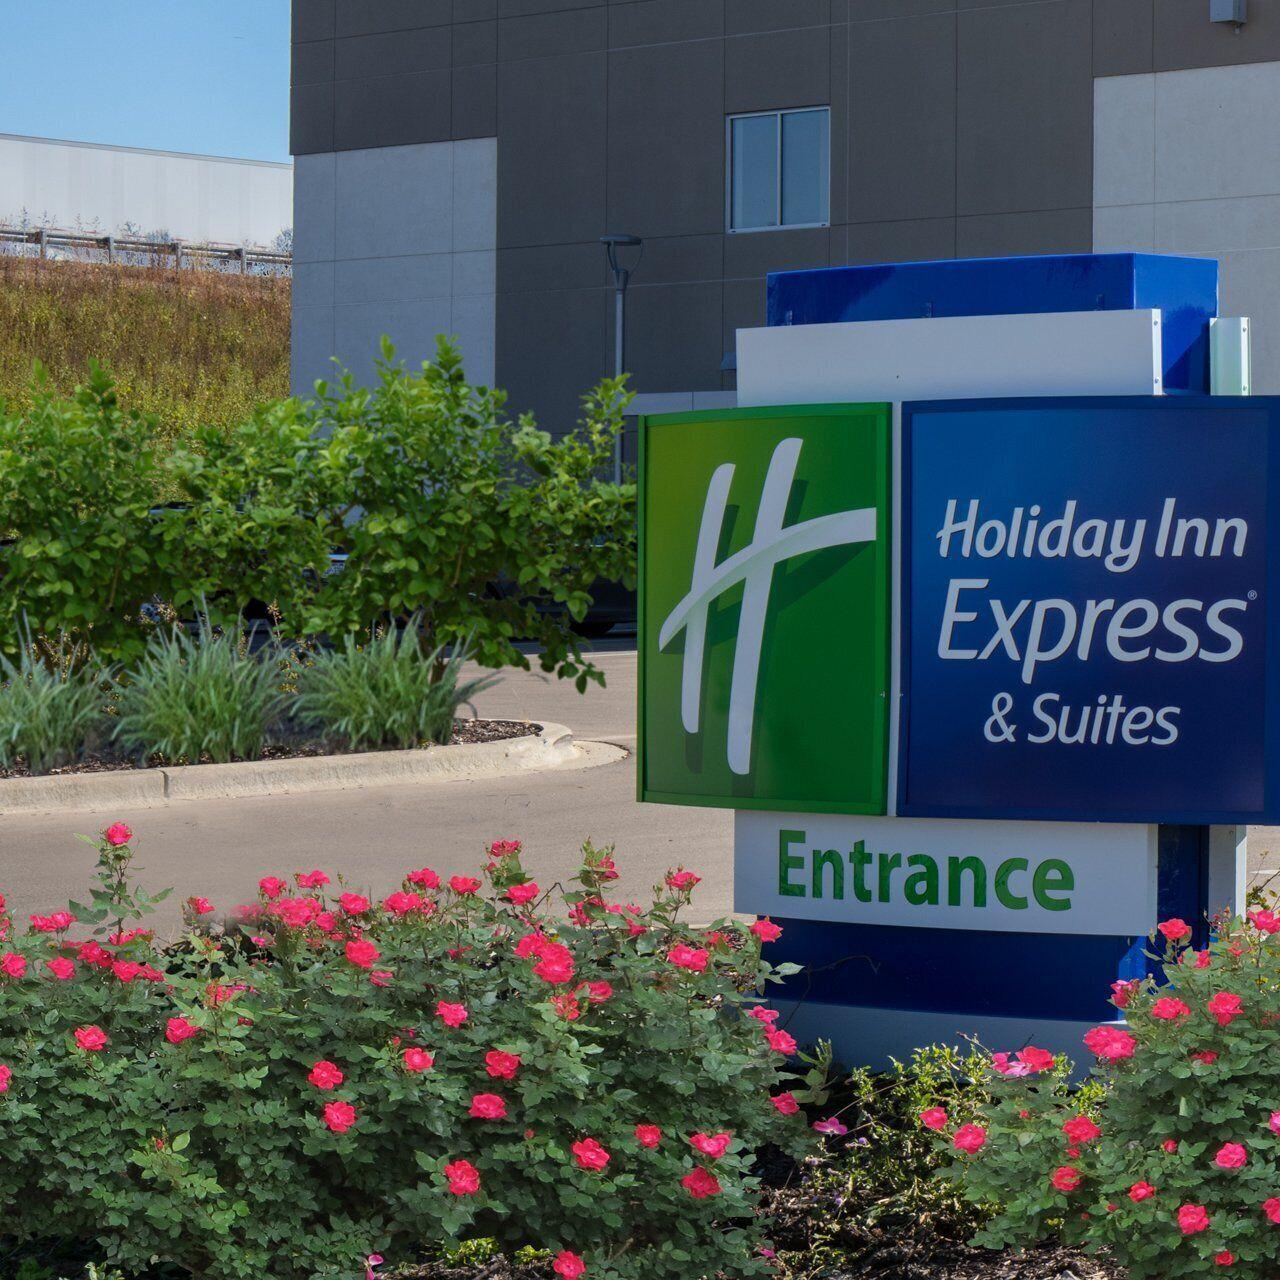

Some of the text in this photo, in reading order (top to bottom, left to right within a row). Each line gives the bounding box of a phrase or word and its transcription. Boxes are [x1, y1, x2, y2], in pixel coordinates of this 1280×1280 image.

[936, 497, 1249, 573] Holiday Inn
[658, 437, 877, 776] H
[937, 578, 1247, 684] Express
[983, 693, 1182, 747] & Suites
[777, 828, 1076, 913] Entrance
